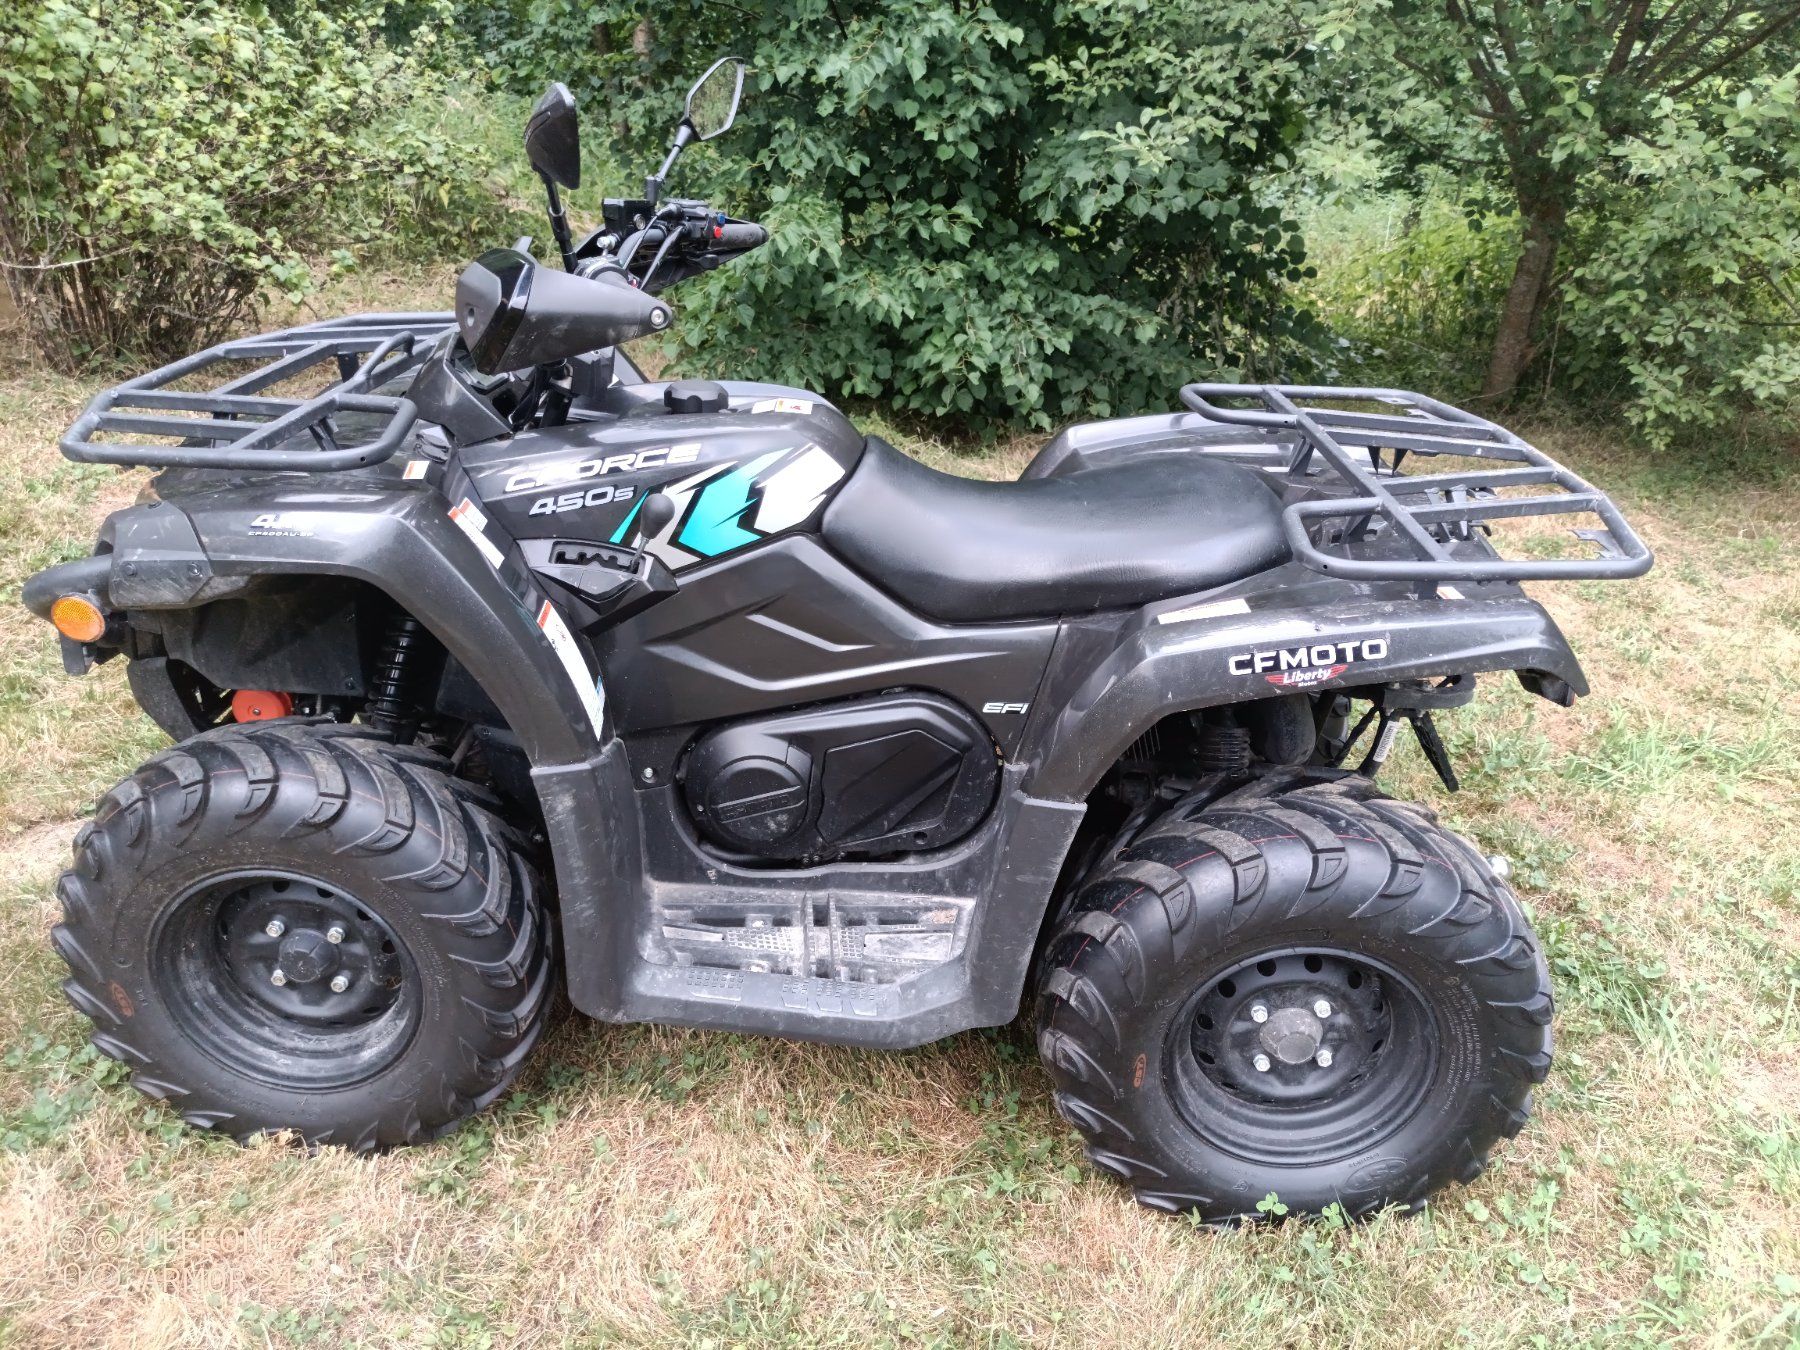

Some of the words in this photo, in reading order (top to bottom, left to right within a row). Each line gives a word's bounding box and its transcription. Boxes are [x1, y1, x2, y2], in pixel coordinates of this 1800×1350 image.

[1228, 639, 1388, 676] CFMOTO
[1283, 667, 1332, 685] Liberty
[982, 702, 1030, 714] EFI
